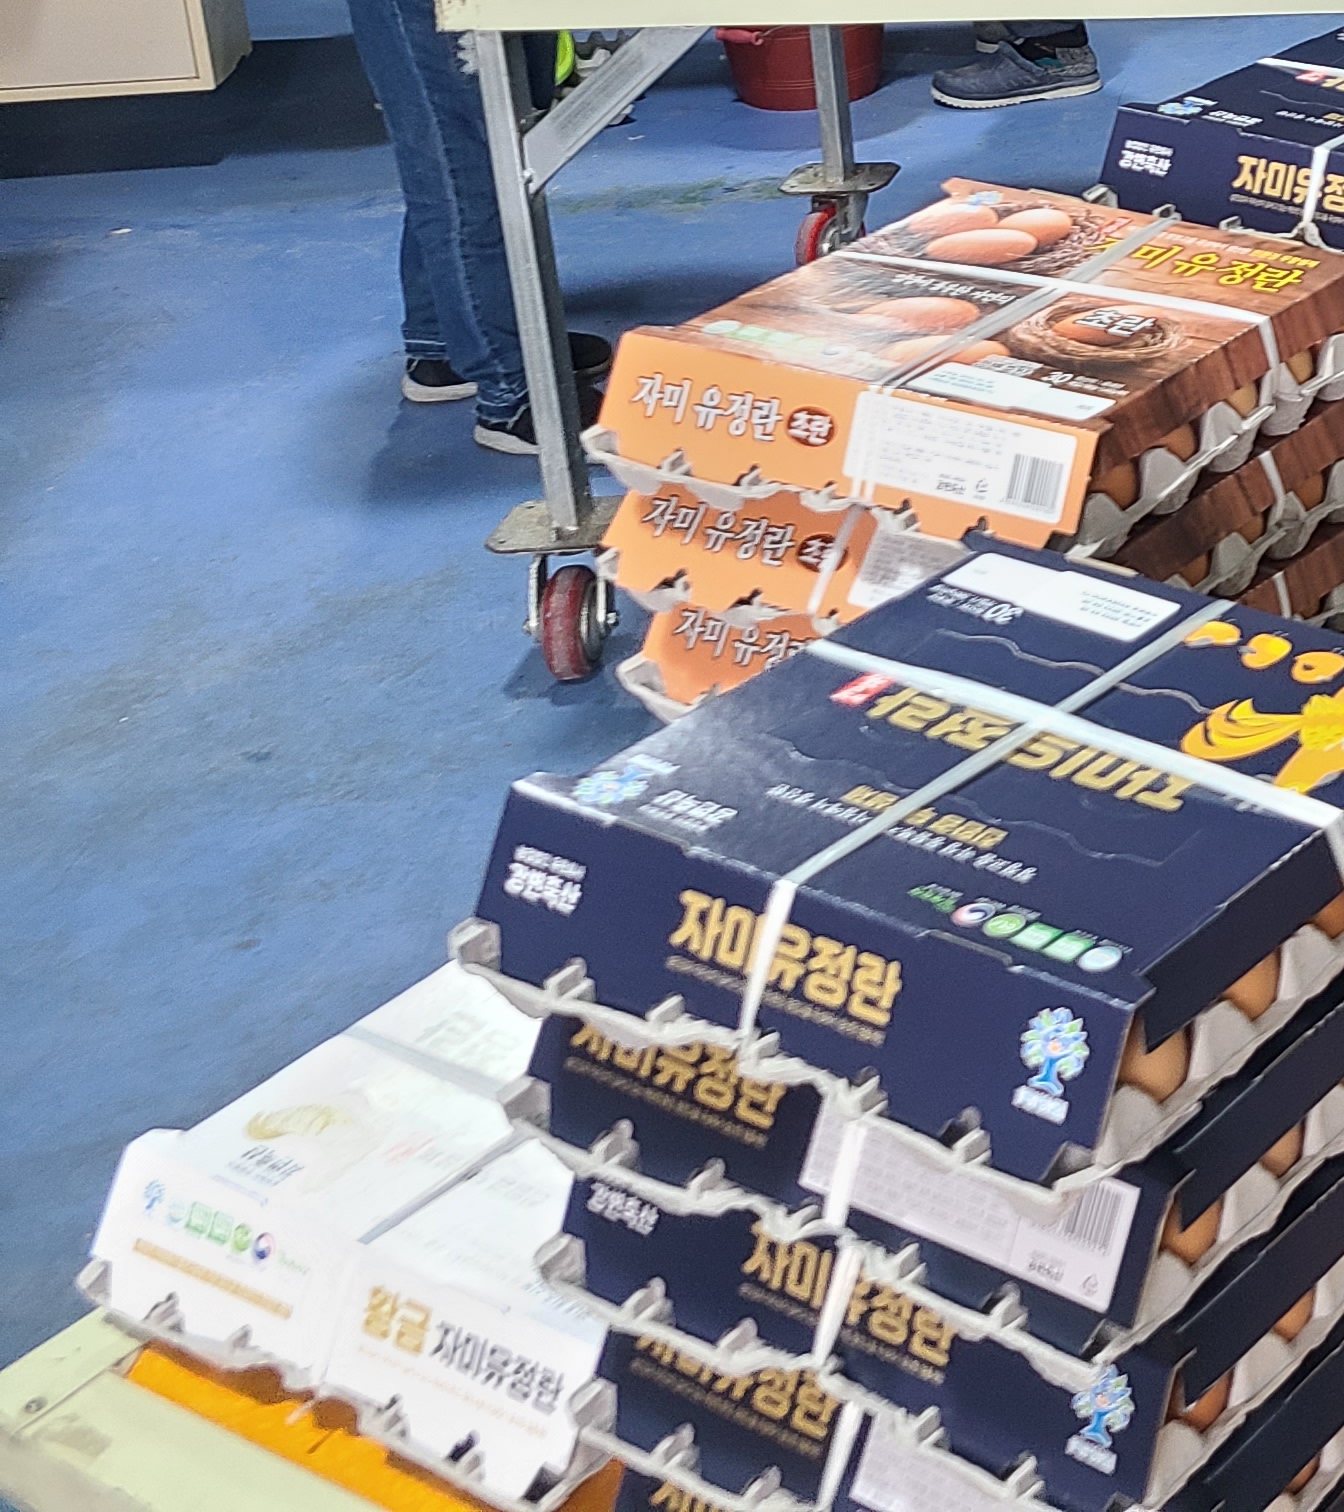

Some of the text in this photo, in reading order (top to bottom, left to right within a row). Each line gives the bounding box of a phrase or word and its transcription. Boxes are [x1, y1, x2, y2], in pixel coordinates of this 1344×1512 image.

[1187, 251, 1306, 294] 유정란
[1075, 308, 1158, 338] 초란
[1041, 370, 1073, 387] 30
[631, 372, 691, 423] 자미
[692, 392, 783, 443] 유정란
[790, 411, 833, 445] 초란
[642, 494, 702, 544] 자미
[704, 511, 796, 568] 유정란
[674, 607, 812, 669] 자미 유정
[988, 602, 1024, 625] 30
[840, 785, 938, 829] 무생제
[503, 861, 584, 918] 강변축산
[668, 888, 903, 1028] 자미유정란
[361, 1285, 434, 1357] 황금
[428, 1320, 568, 1415] 자미유정란
